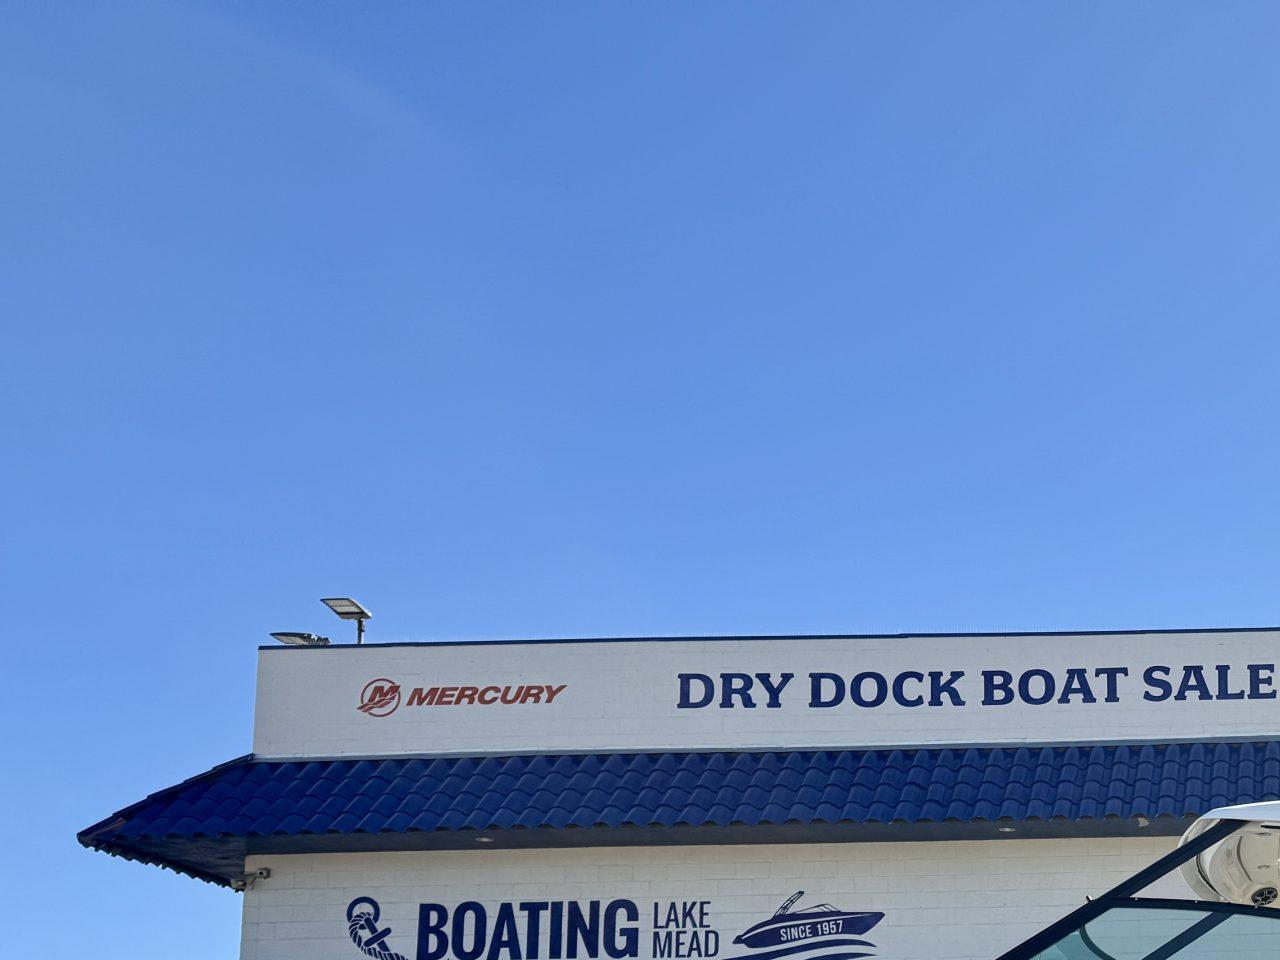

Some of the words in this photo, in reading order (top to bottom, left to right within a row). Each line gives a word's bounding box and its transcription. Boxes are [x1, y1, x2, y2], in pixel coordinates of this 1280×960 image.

[406, 684, 568, 706] MERCURY
[676, 672, 795, 709] DRY
[808, 670, 966, 709] DOCK
[981, 666, 1129, 706] BOAT
[653, 901, 711, 928] LAKE
[652, 929, 719, 959] MEAD
[780, 925, 813, 941] SINCE
[816, 920, 843, 936] 1957
